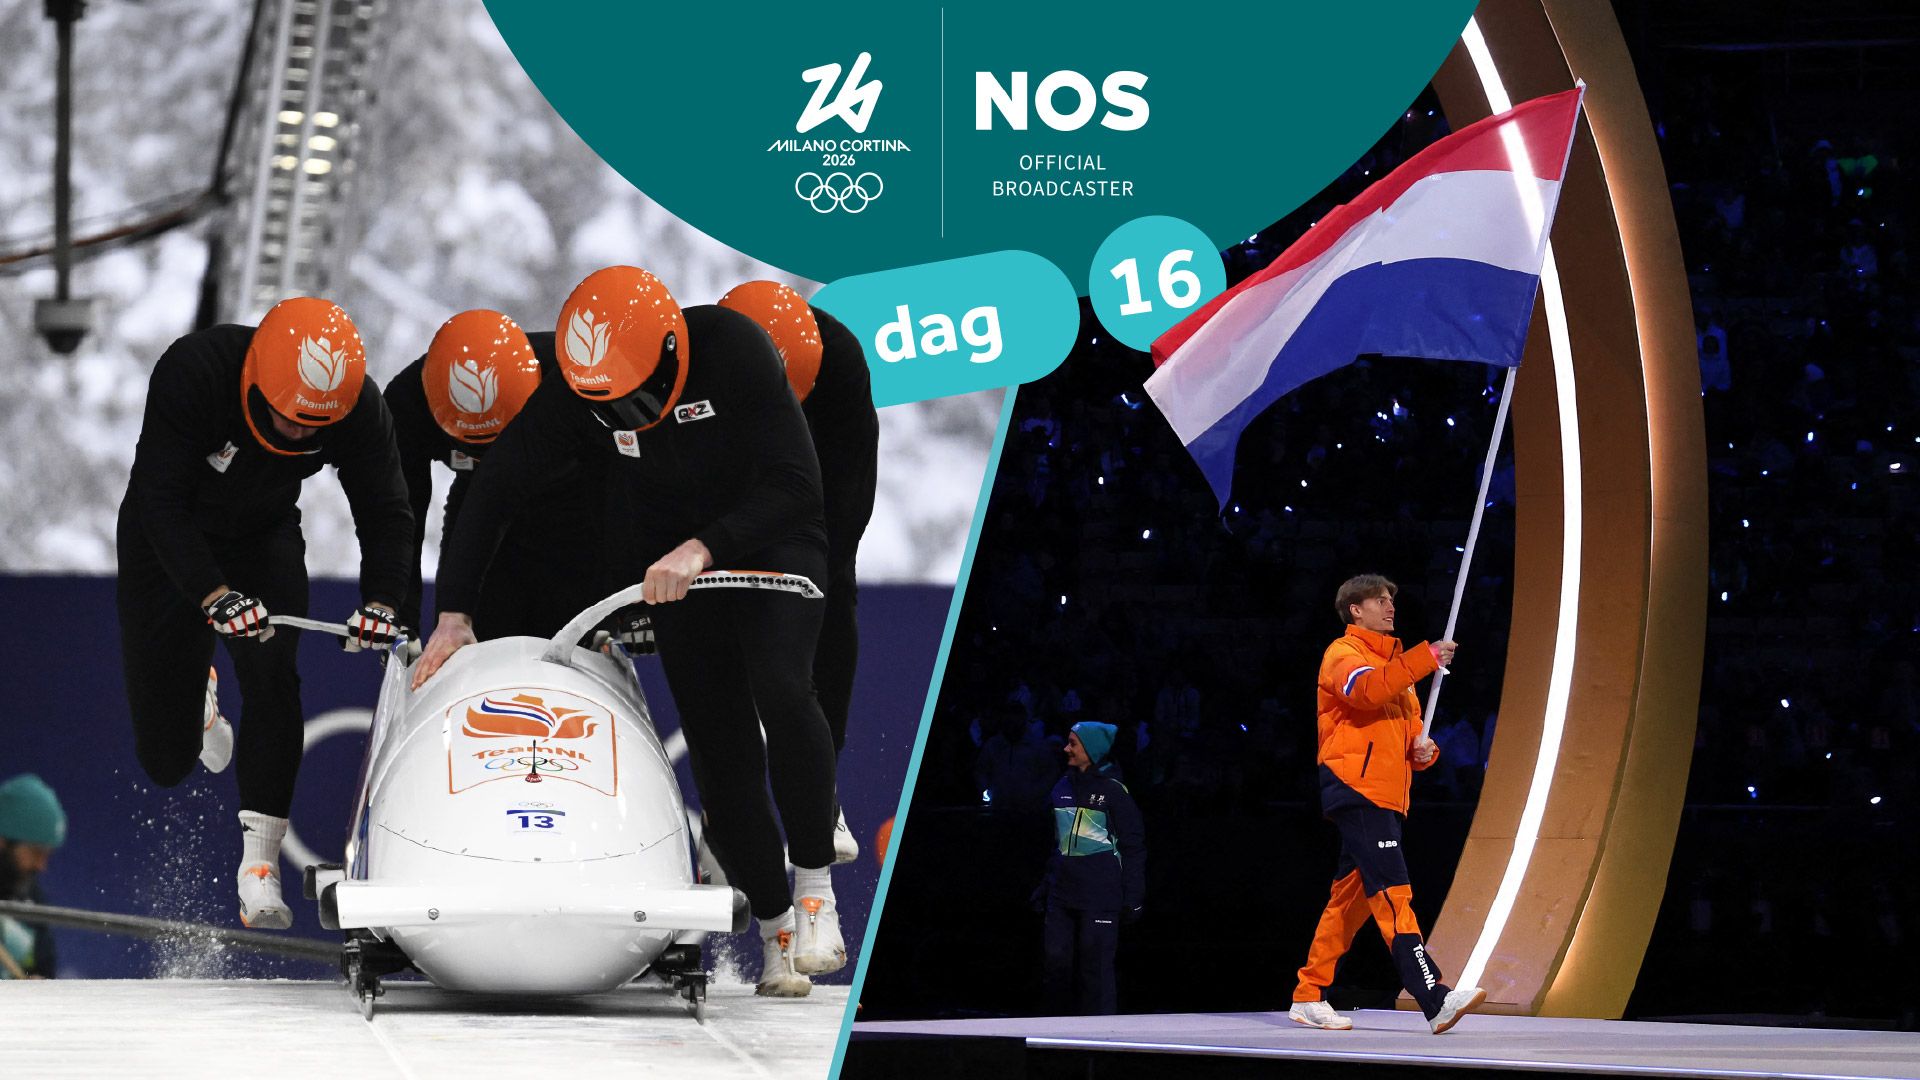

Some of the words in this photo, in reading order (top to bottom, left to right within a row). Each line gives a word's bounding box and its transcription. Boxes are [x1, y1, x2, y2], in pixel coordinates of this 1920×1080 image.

[569, 370, 612, 386] TeamNL
[295, 394, 338, 411] TeamNL
[455, 417, 500, 431] TeamNL
[631, 617, 651, 629] SEI
[471, 745, 592, 763] TeamNL
[518, 815, 554, 829] 13
[1413, 943, 1437, 991] TeamNL
